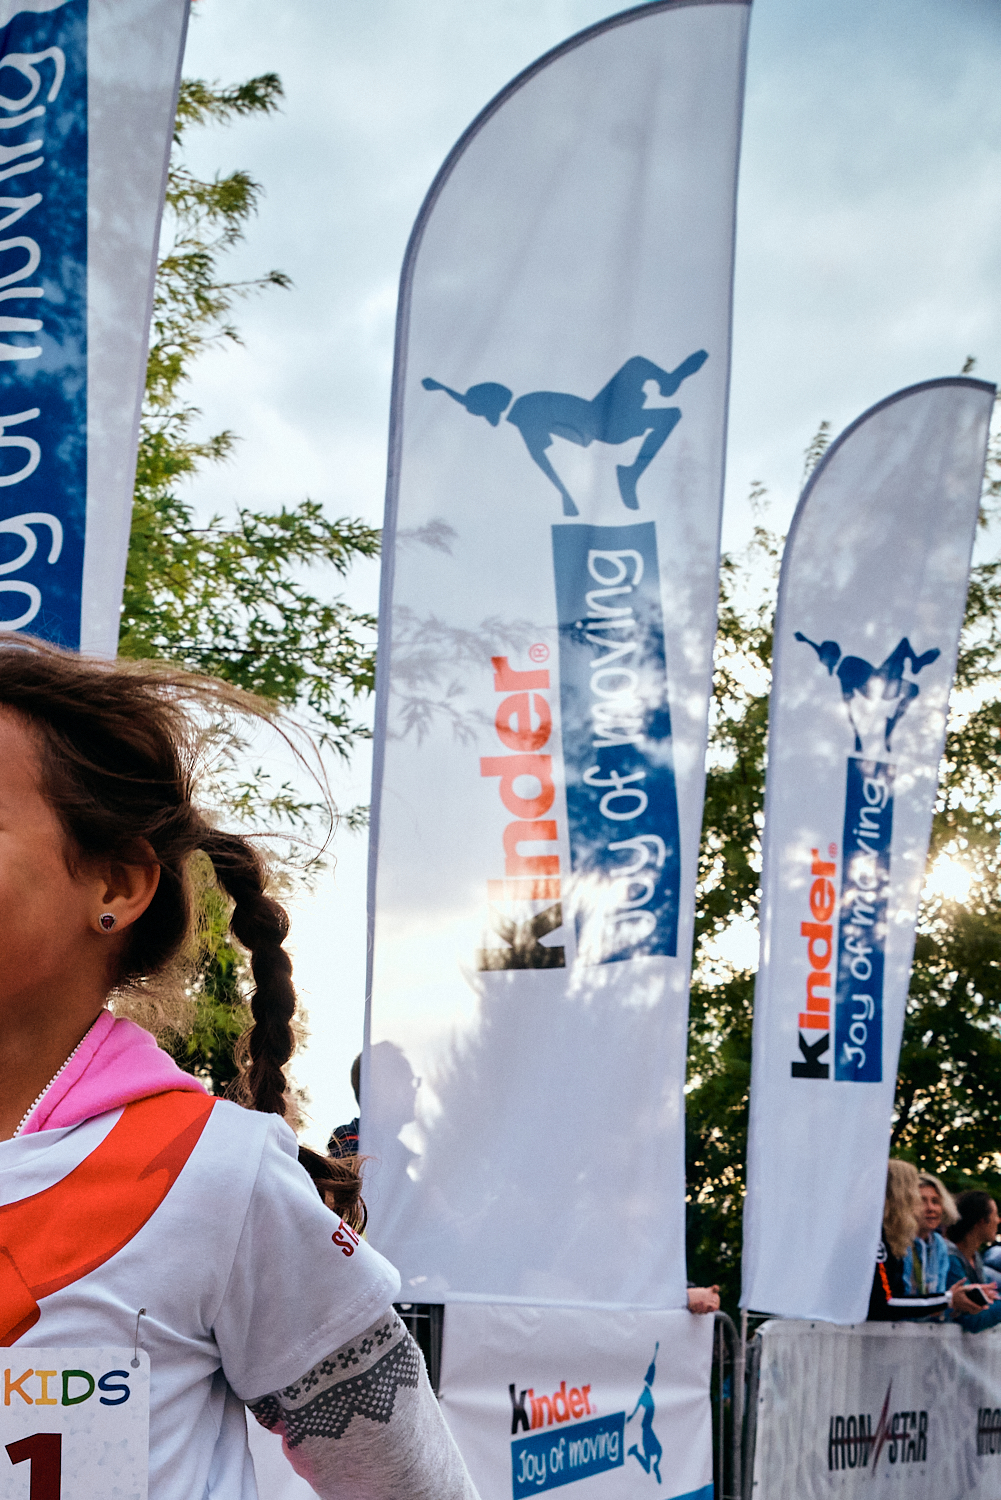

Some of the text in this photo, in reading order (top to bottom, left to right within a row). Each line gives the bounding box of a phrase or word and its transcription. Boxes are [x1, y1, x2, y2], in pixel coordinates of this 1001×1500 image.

[575, 549, 644, 748] moving
[852, 777, 890, 926] moving
[842, 994, 875, 1068] Joy
[332, 1219, 360, 1257] ST
[517, 1449, 547, 1486] Joy
[568, 1430, 619, 1468] moving
